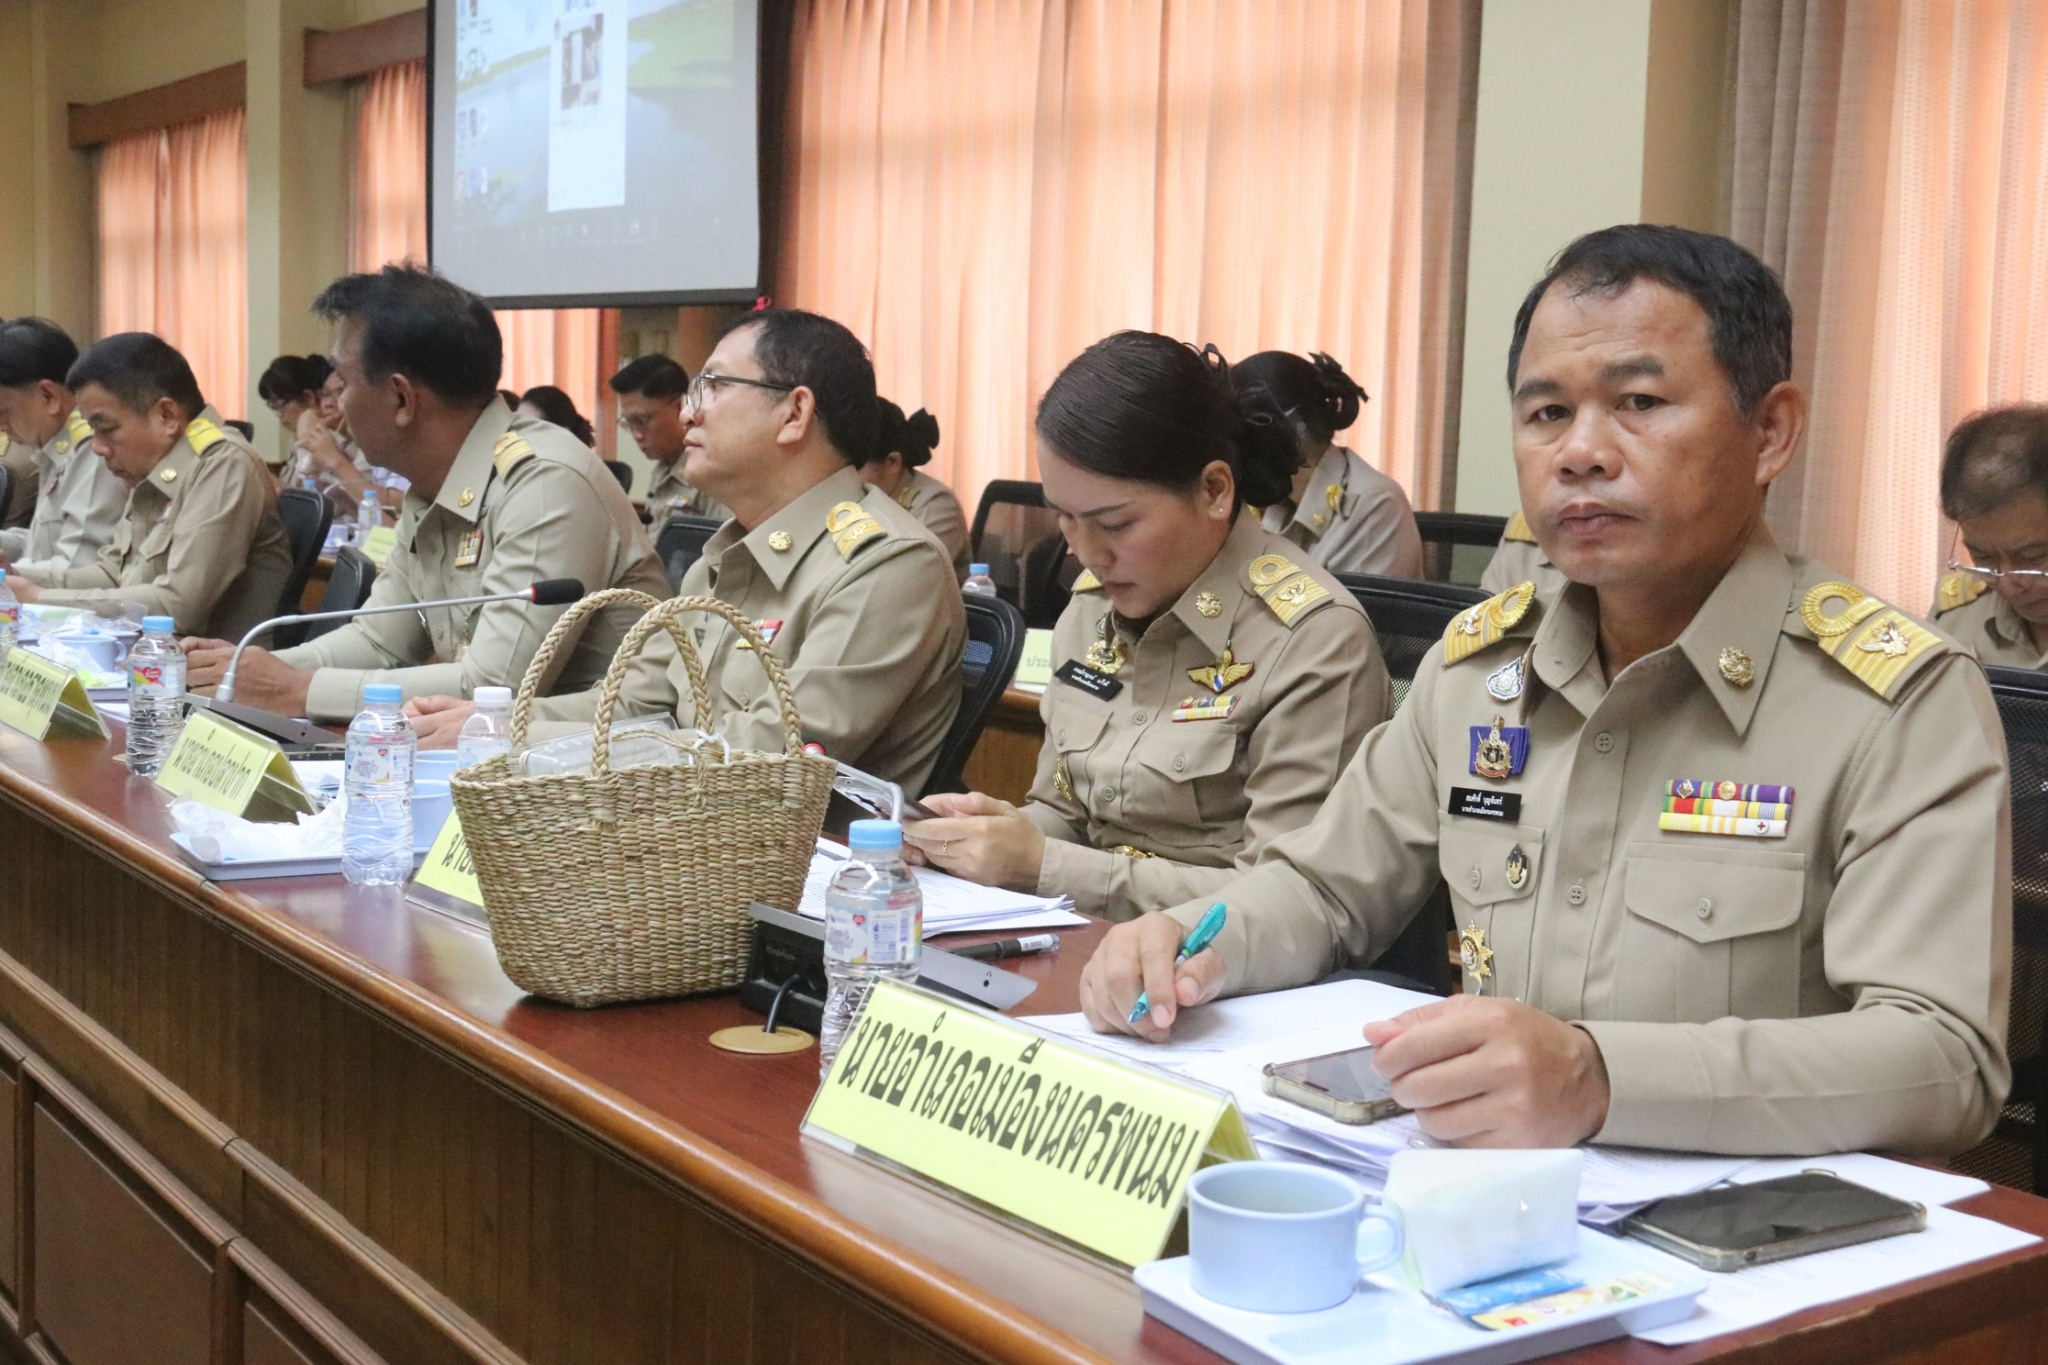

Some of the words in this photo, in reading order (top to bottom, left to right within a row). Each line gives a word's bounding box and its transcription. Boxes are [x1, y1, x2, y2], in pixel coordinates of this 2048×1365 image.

[837, 1010, 1200, 1209] นายอำเภอเมืองนครพนม
